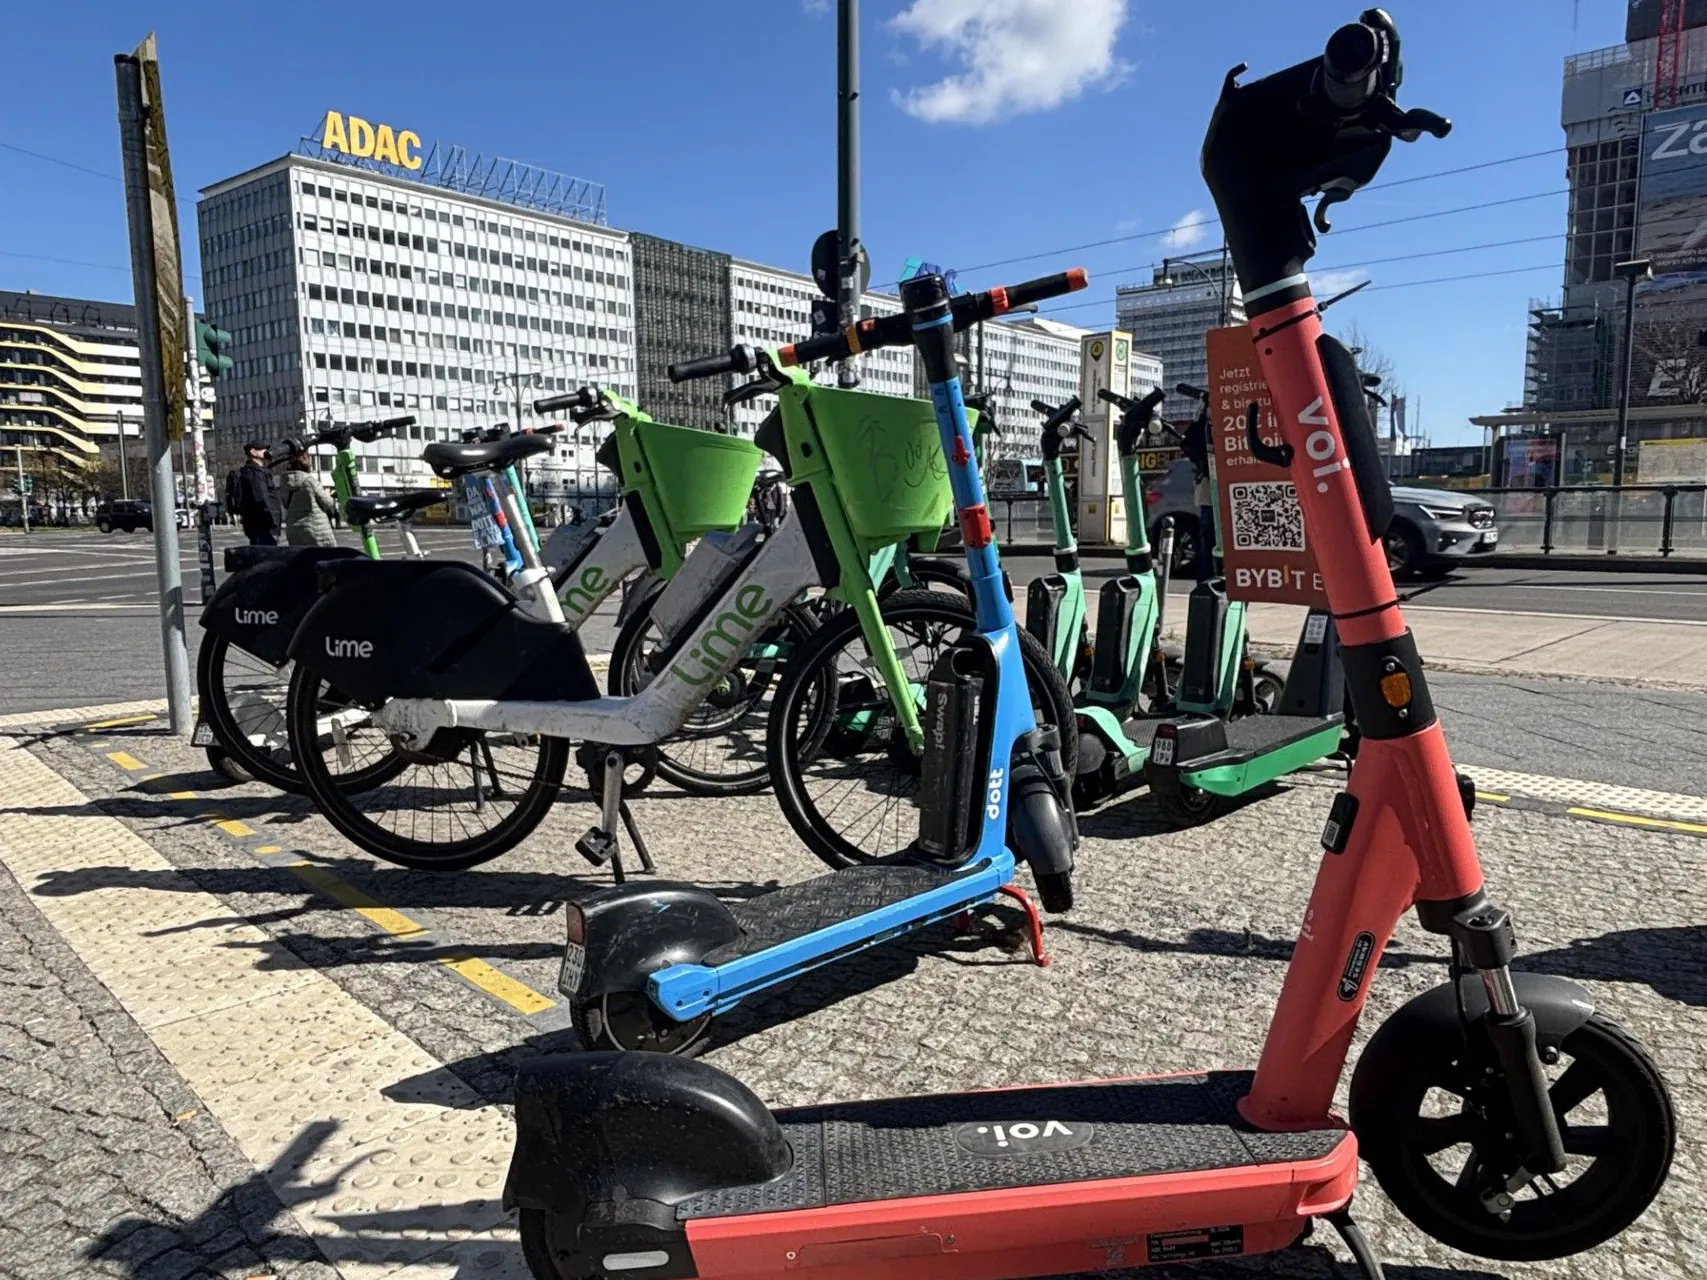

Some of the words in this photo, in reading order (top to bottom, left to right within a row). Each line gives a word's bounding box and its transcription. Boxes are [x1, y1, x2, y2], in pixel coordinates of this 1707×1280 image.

[323, 110, 422, 170] ADAC
[1219, 367, 1250, 380] Jetzt
[1221, 399, 1230, 410] &
[1235, 565, 1305, 590] BYBIT
[235, 607, 279, 624] Lime
[325, 636, 374, 658] Lime
[670, 584, 773, 686] Lime
[987, 767, 1004, 820] dott
[977, 1120, 1074, 1147] voi.
